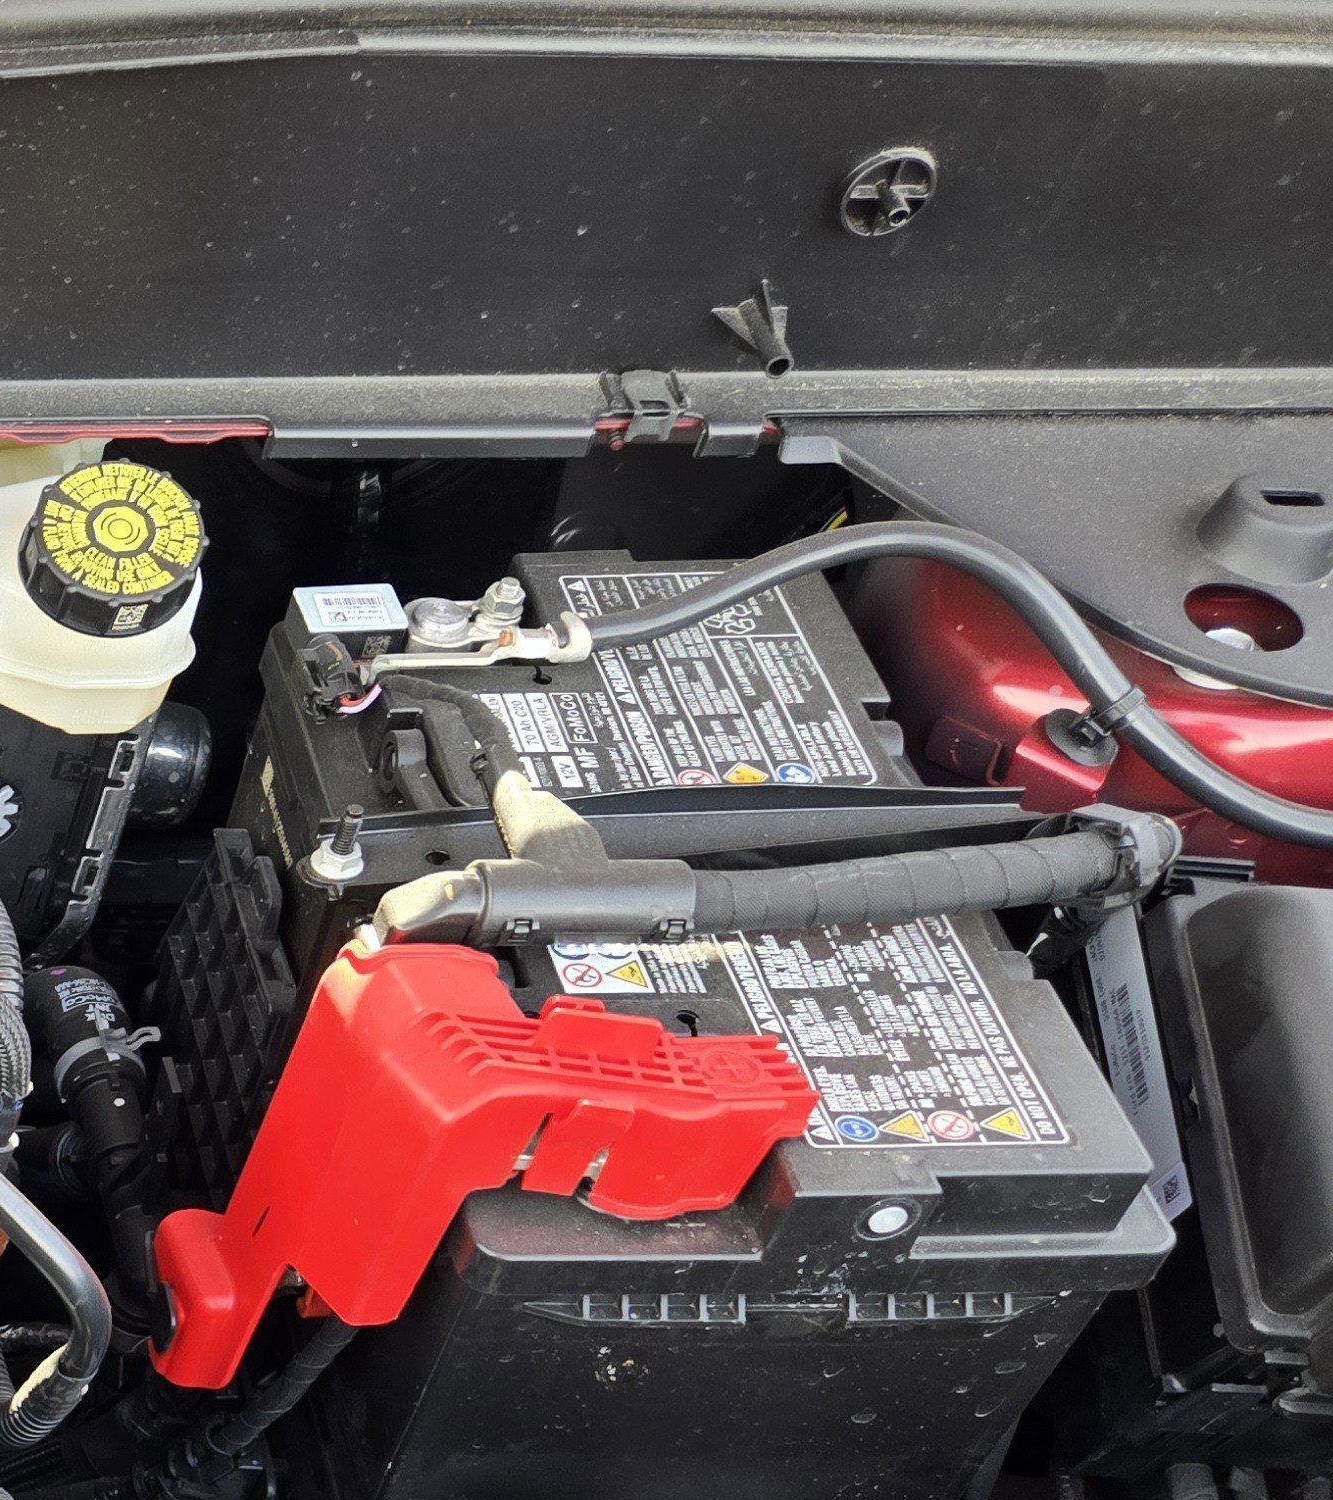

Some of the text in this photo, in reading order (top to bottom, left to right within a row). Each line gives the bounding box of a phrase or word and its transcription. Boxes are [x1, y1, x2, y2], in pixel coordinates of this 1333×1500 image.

[59, 466, 102, 494] ATTENTION
[101, 463, 147, 479] NETTOYER
[146, 470, 161, 484] LE
[157, 478, 192, 510] BOUCHON
[183, 512, 200, 536] AVANT
[43, 526, 62, 550] FLUID
[51, 550, 77, 573] FROM
[69, 550, 114, 580] REMOVING
[117, 570, 135, 582] USE
[137, 562, 163, 580] ONLY
[85, 547, 117, 570] CLEAN
[119, 552, 154, 570] FILLER
[72, 570, 83, 581] A
[83, 573, 120, 594] SEALED
[122, 570, 175, 594] CONTAINER
[771, 676, 794, 703] CONTRA
[510, 700, 539, 745] 70 Ah C20
[532, 697, 561, 746] AGM/VRLA
[556, 694, 590, 741] FoMoCo
[573, 746, 599, 767] MF
[623, 711, 671, 778] DANGER/POISON
[794, 723, 832, 776] NON-SPILLABLE
[804, 721, 844, 776] Lead Acid Battery
[557, 762, 576, 779] 12V
[851, 758, 871, 775] ANTI
[752, 944, 772, 960] LOS
[724, 940, 777, 1018] PELIGRO/VENENO
[777, 948, 809, 988] EXPLOSIVOS
[789, 999, 808, 1011] GAZ
[833, 1005, 849, 1013] LA
[815, 1022, 844, 1056] EXPLOSIFS
[828, 1020, 857, 1056] CAUSER DES
[841, 1021, 871, 1055] BLESSURES
[938, 942, 1056, 1133] DO NOT OPEN. NE PAS OUVRIR. NO LA ABRA.
[801, 1047, 817, 1056] SE
[813, 1045, 830, 1056] LES
[819, 1087, 843, 1111] SHIELD
[825, 1073, 857, 1111] EXPLOSIVE
[860, 1090, 883, 1111] CAUSE
[866, 1075, 897, 1110] BLINDNESS
[893, 1099, 910, 1109] OR
[995, 1095, 1012, 1104] OR
